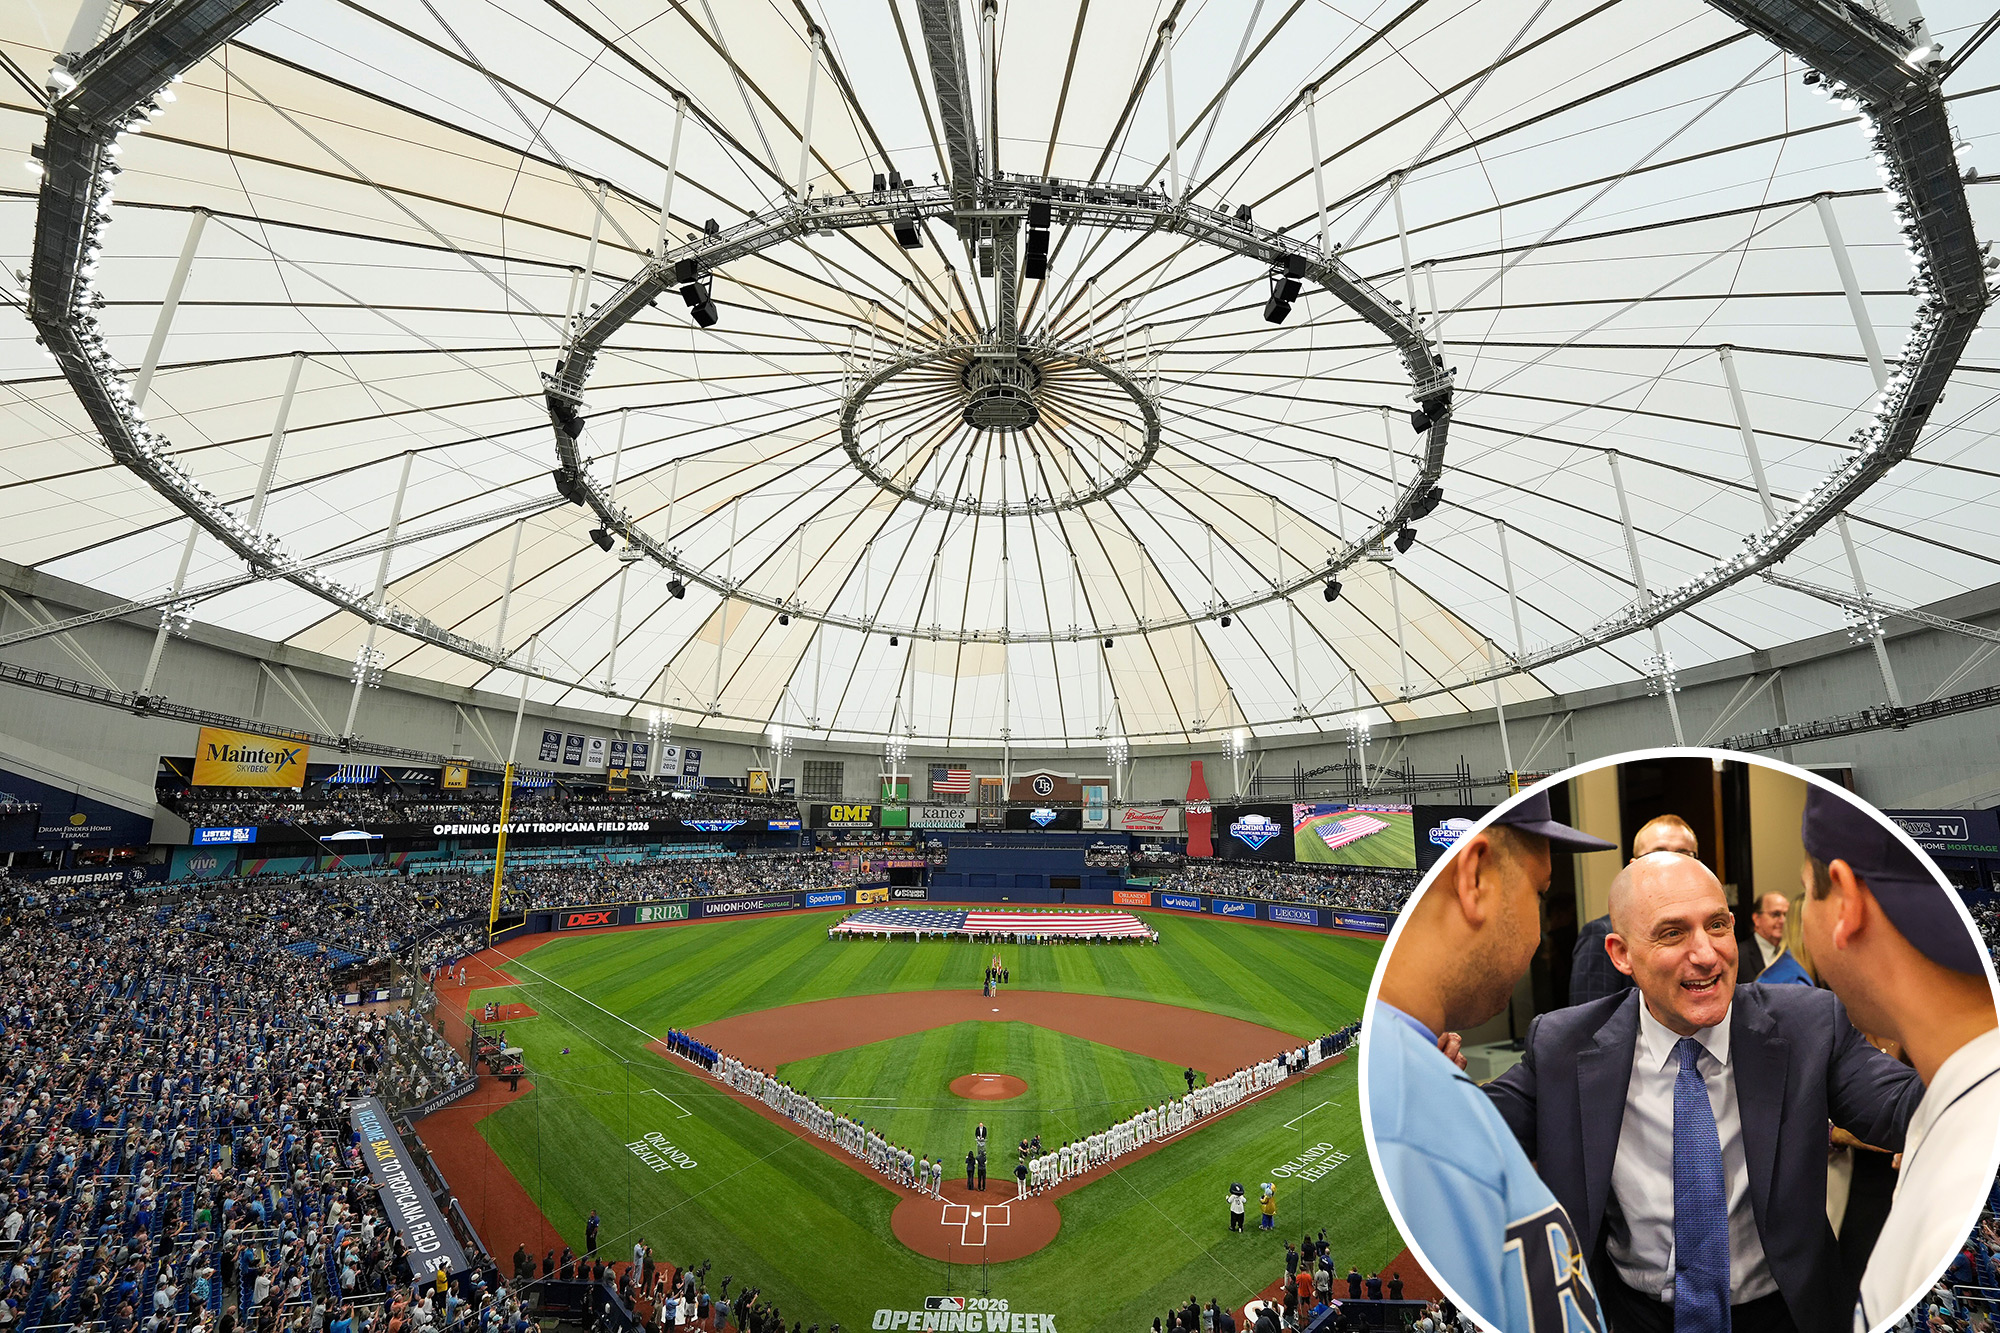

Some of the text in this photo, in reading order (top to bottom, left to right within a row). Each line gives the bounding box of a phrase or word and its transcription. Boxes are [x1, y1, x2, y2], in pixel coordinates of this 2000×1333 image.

[206, 743, 302, 773] MaintenX
[236, 764, 269, 773] SKYDECK
[662, 763, 676, 771] 2020
[1036, 779, 1051, 792] TB
[829, 805, 872, 822] GMF
[922, 807, 965, 819] kanes
[1127, 812, 1164, 820] Budweiser
[433, 822, 650, 835] OPENING DAY AT TROPICANA FIELD 2026
[1936, 825, 1959, 836] .TV
[1947, 844, 1998, 852] MORTGAGE
[190, 859, 217, 869] VIVA
[49, 872, 123, 885] SOMOS RAYS
[809, 895, 839, 904] Spectrum
[1175, 898, 1197, 908] Webull
[566, 912, 612, 927] DEX
[653, 905, 685, 920] RIPA
[1275, 908, 1311, 920] LECOM
[424, 1082, 475, 1115] RAYMOND JAMES
[356, 1109, 387, 1142] WELCOME
[370, 1139, 397, 1162] BACK
[624, 1139, 673, 1173] HEALTH
[643, 1131, 698, 1169] ORLANDO
[380, 1158, 402, 1173] TO
[1271, 1142, 1334, 1178] ORLANDO
[1295, 1151, 1351, 1183] HEALTH
[386, 1170, 426, 1224] TROPICANA
[408, 1221, 441, 1253] FIELD
[967, 1298, 1009, 1312] 2026
[872, 1309, 1057, 1333] OPENING WEEK
